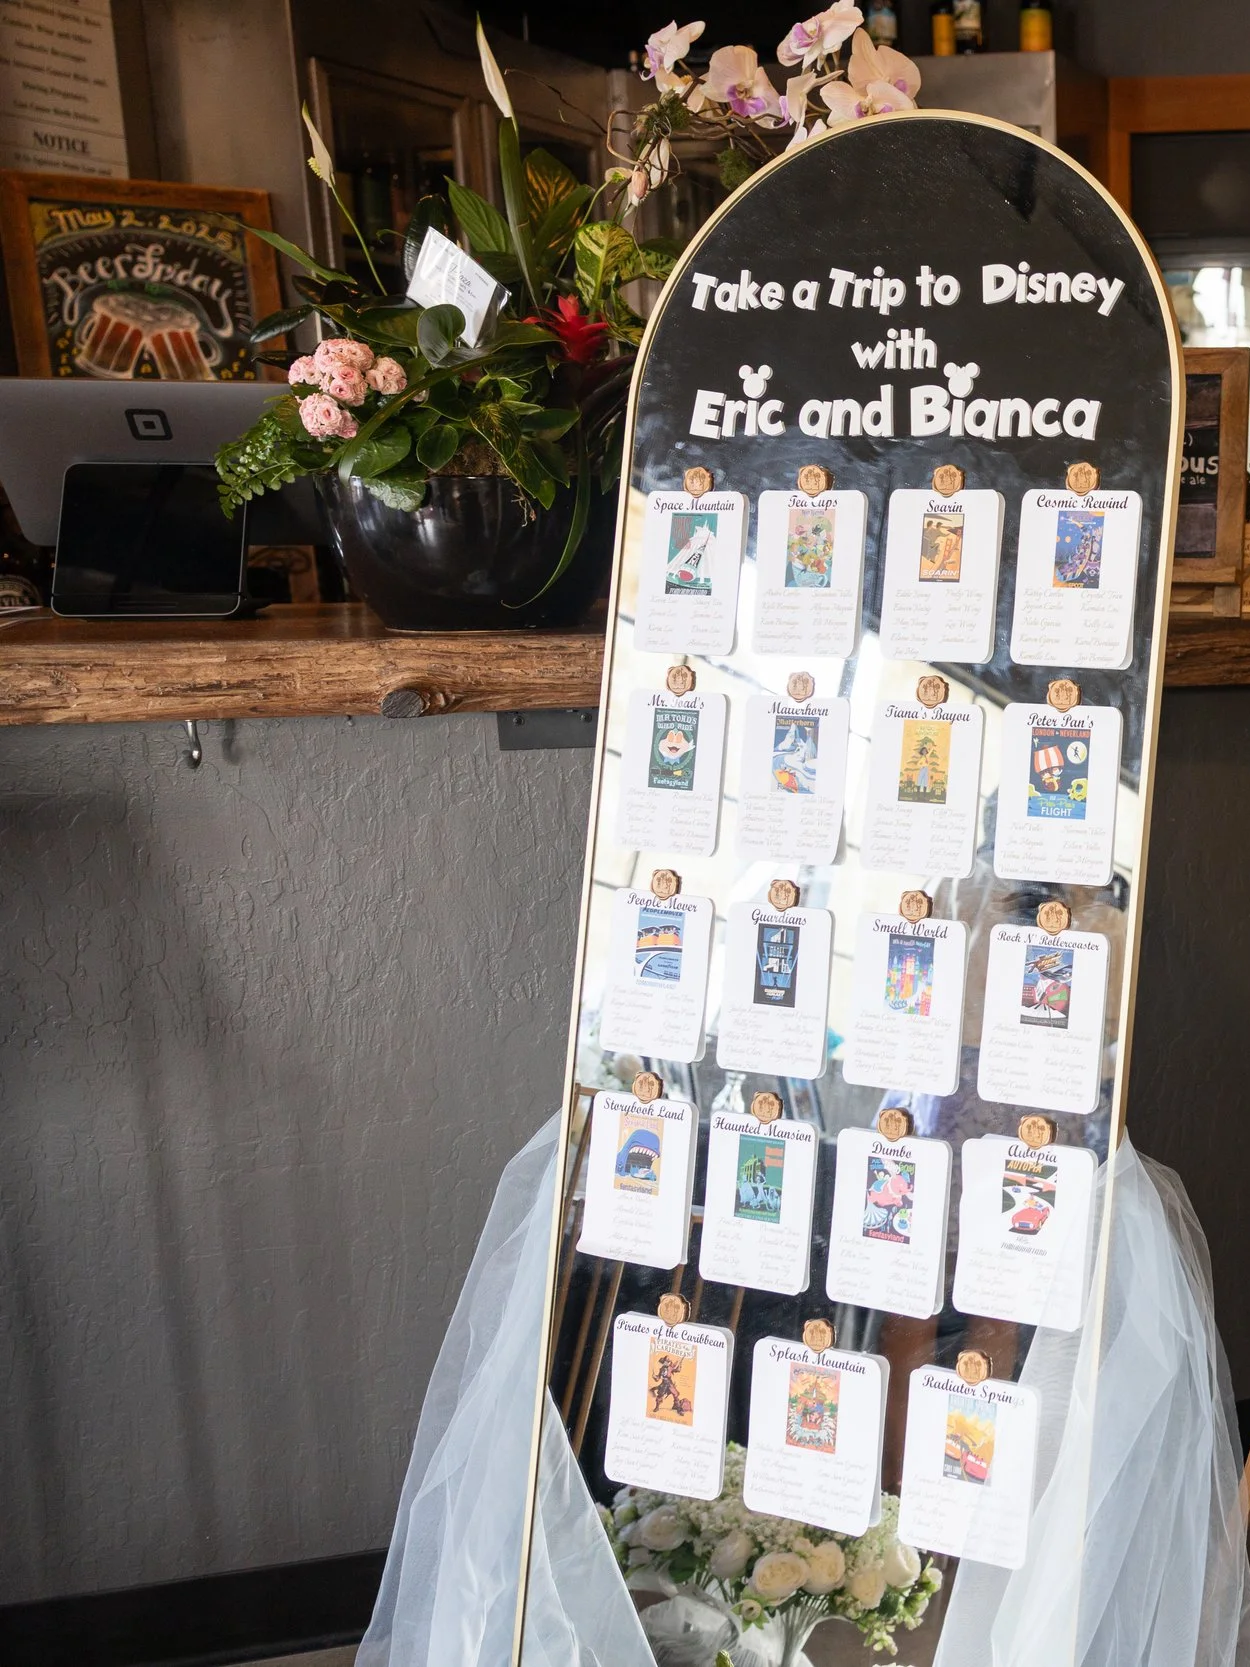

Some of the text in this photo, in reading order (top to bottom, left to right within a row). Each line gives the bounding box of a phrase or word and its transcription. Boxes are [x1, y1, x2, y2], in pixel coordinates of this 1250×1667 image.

[33, 130, 89, 154] NOTICE
[50, 208, 115, 234] May
[42, 243, 237, 338] Beer Friday
[691, 260, 1125, 316] Take a Trip to Disney
[850, 327, 938, 371] with
[689, 362, 1102, 441] Eric and Bianca
[653, 497, 736, 513] Space Mountain
[788, 496, 808, 508] Tea
[926, 500, 964, 513] Soarin
[1037, 495, 1129, 509] Cosmic Rewind
[648, 694, 667, 707] Mr.
[885, 704, 971, 726] Tiana's Bayou
[1027, 712, 1094, 728] Peter Pan's
[1041, 806, 1072, 817] FLIGHT
[627, 891, 698, 913] People Mover
[751, 908, 807, 925] Guardians
[872, 918, 949, 939] Small World
[997, 930, 1022, 943] Rock
[1038, 935, 1100, 951] Rollercoaster
[604, 1096, 686, 1121] Storybook Land
[712, 1116, 813, 1143] Haunted Mansion
[871, 1140, 913, 1159] Dumbo
[1008, 1144, 1057, 1167] Autopia
[616, 1318, 726, 1349] Pirates of the Caribbean
[769, 1343, 867, 1376] Splash Mountain
[922, 1374, 977, 1397] Radiator
